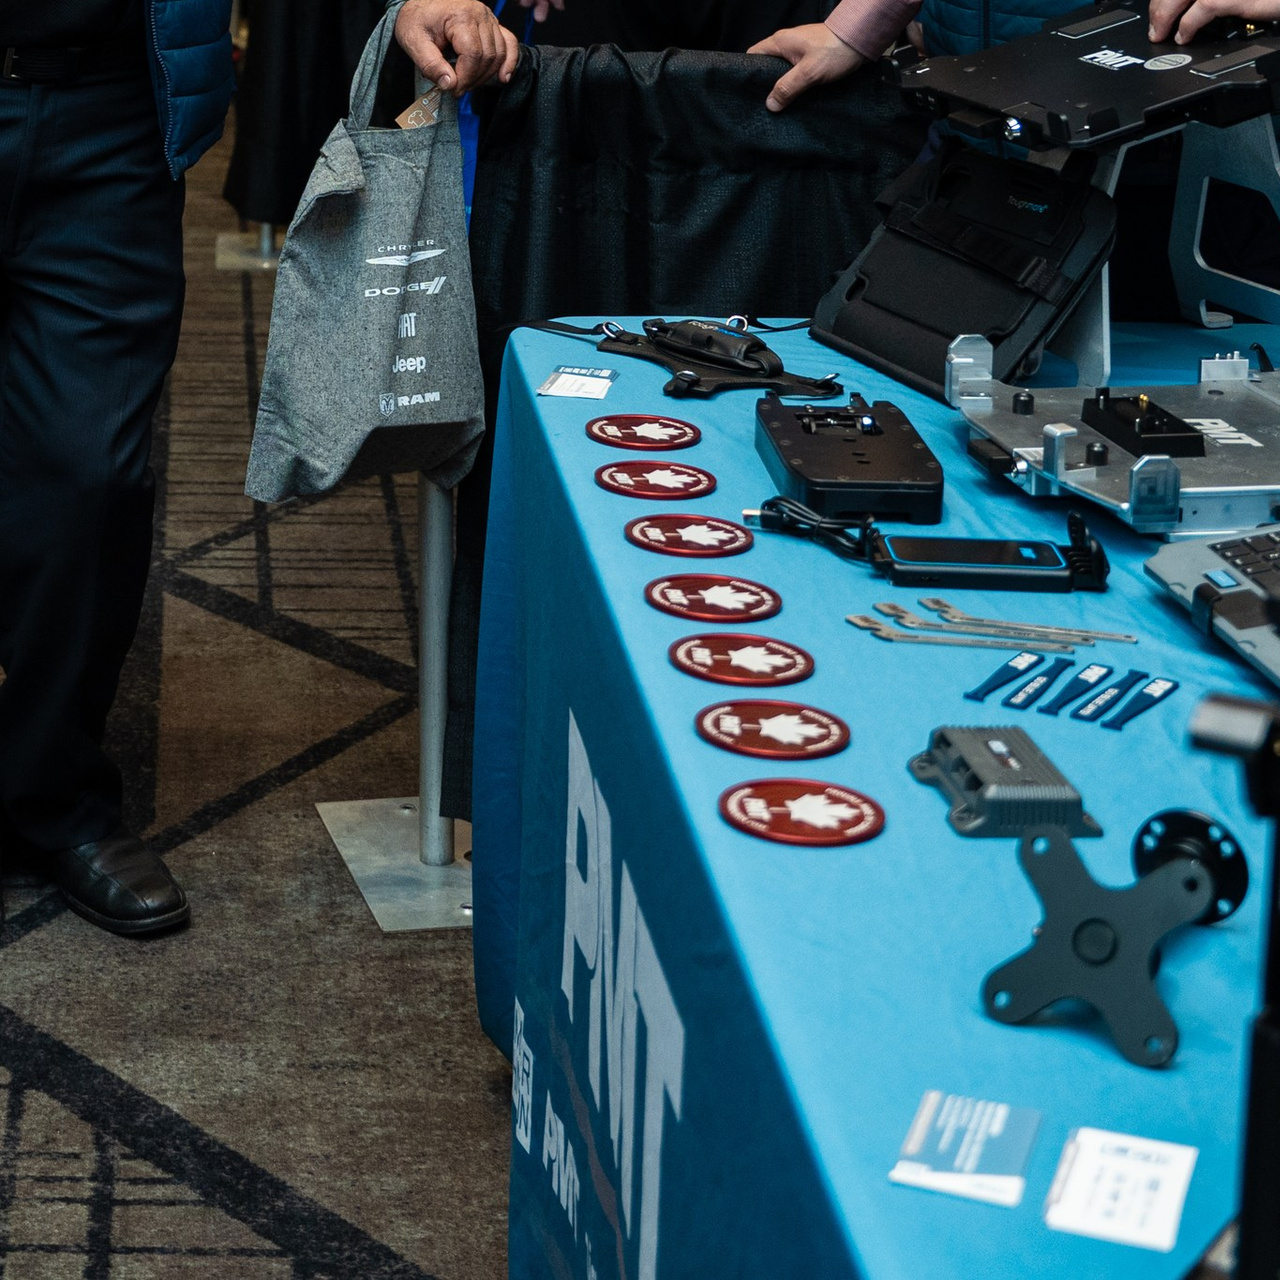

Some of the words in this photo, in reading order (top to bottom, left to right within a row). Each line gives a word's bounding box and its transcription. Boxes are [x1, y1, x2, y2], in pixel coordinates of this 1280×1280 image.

[1081, 49, 1145, 68] PMT
[377, 239, 435, 253] CHRER
[398, 312, 417, 339] IAT
[392, 355, 426, 373] Jeep
[397, 391, 440, 407] RAM
[561, 707, 684, 1280] PMT
